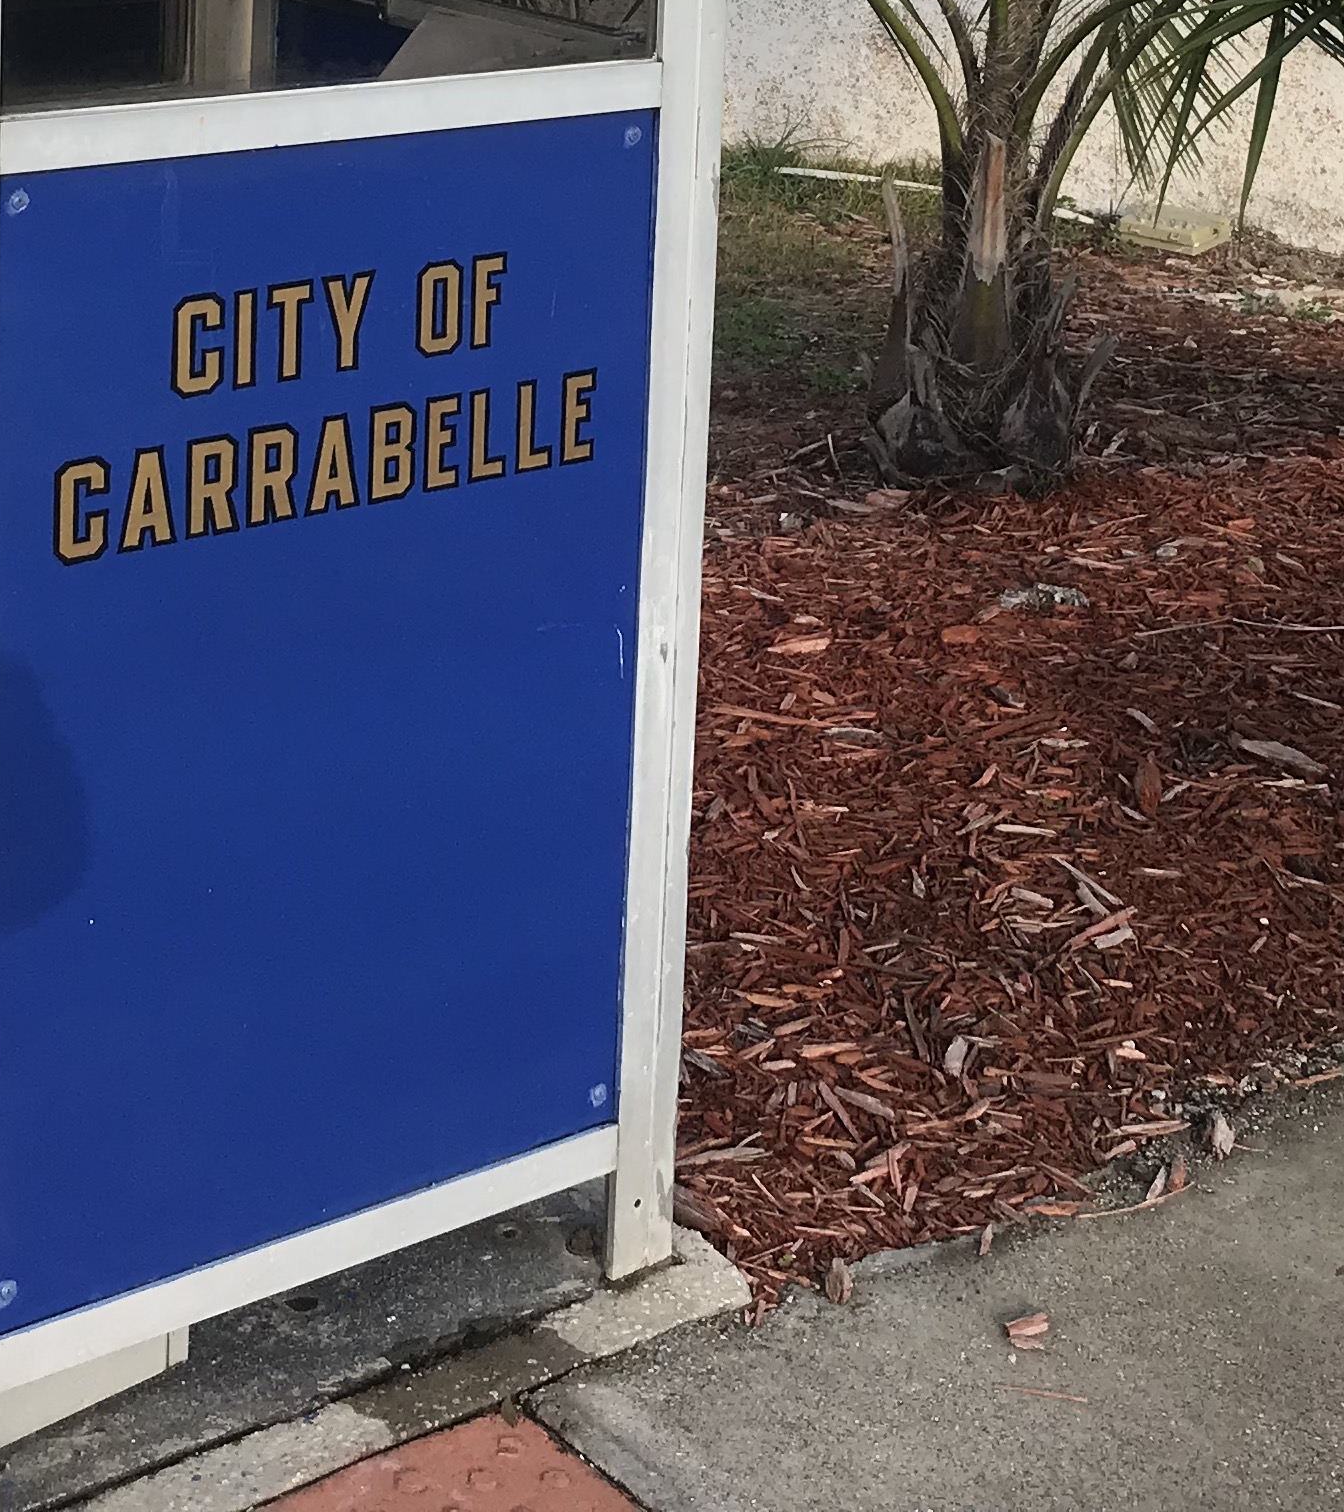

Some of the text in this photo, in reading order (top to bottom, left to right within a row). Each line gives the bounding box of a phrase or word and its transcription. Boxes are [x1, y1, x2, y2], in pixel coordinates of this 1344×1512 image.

[170, 251, 508, 399] CITY OF
[53, 367, 598, 566] CARRABELLE
